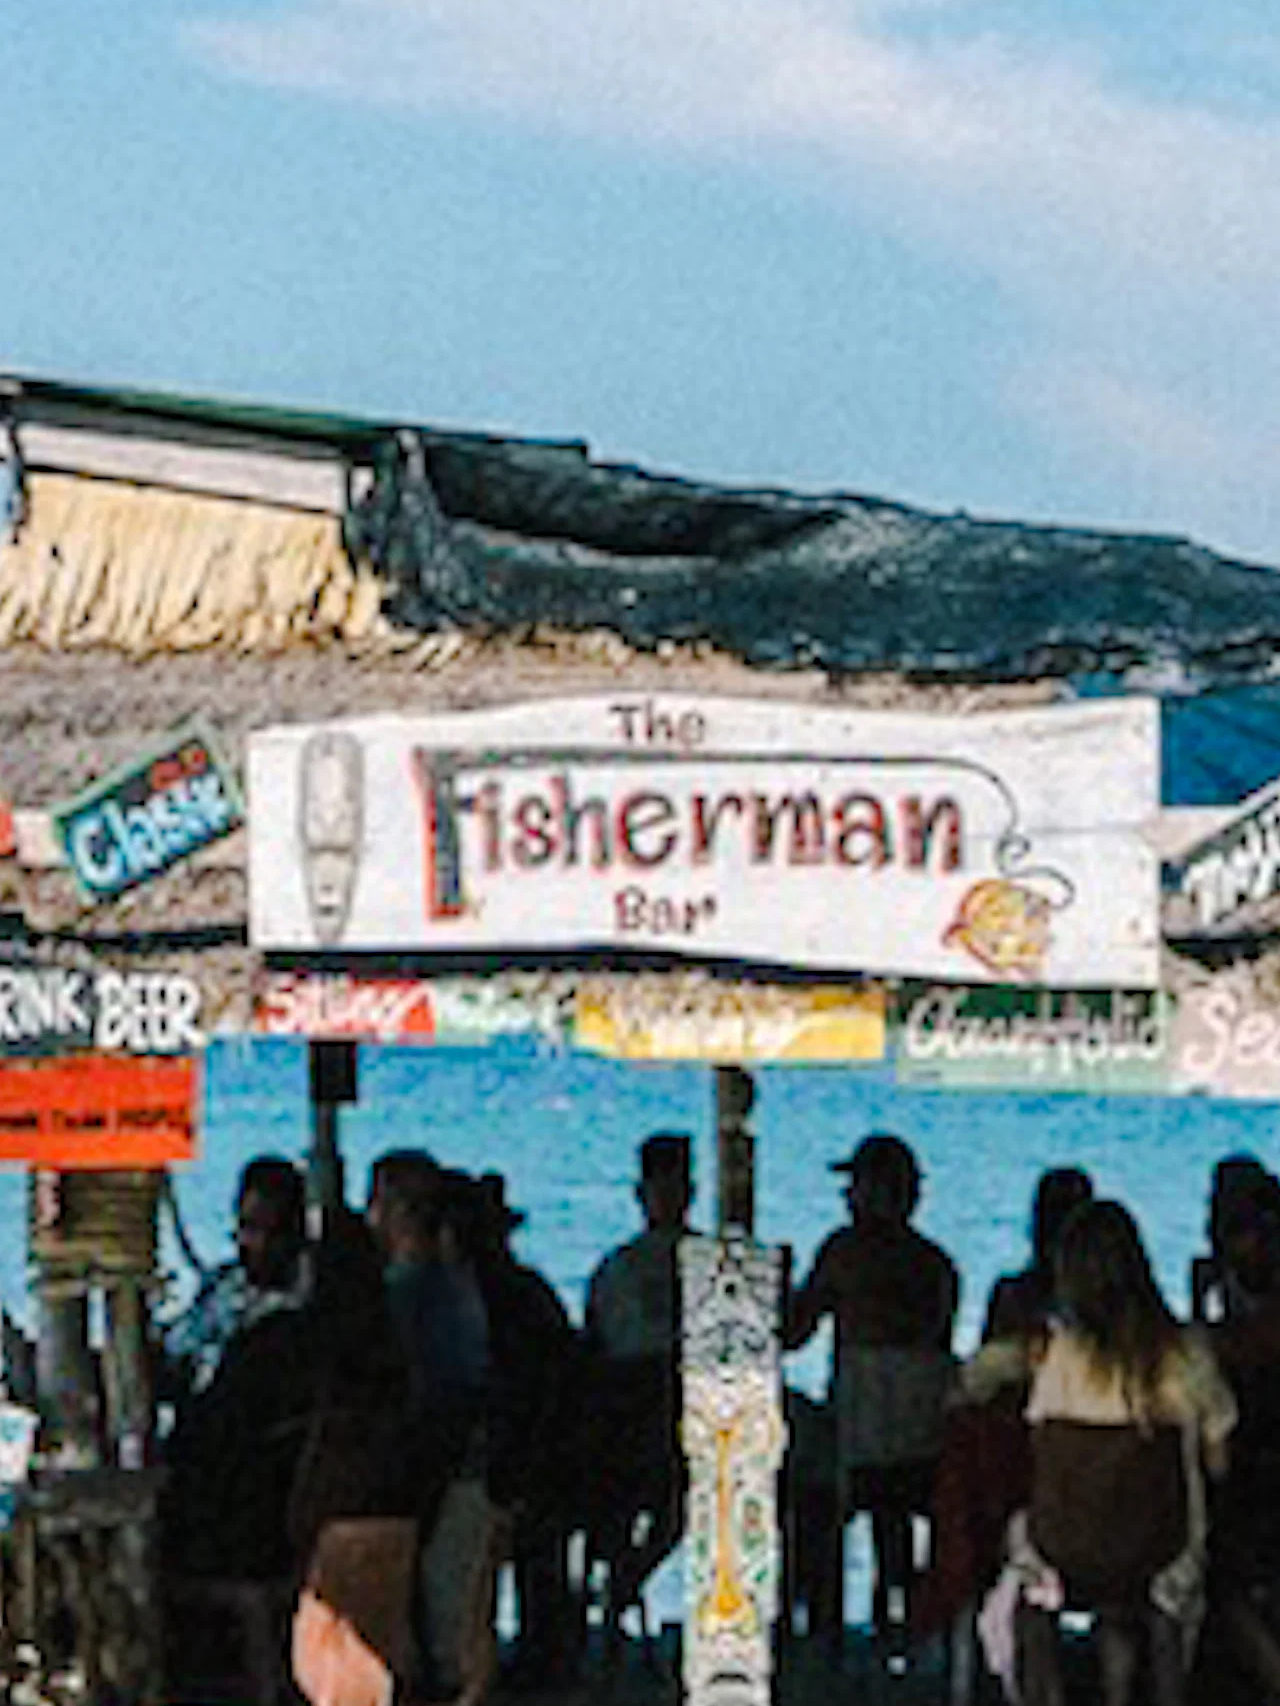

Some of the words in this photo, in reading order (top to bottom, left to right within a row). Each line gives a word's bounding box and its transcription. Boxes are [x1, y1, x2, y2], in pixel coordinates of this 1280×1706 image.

[609, 704, 707, 746] The
[413, 748, 963, 920] Fisherman
[613, 886, 718, 936] Bar
[94, 969, 208, 1053] BEER
